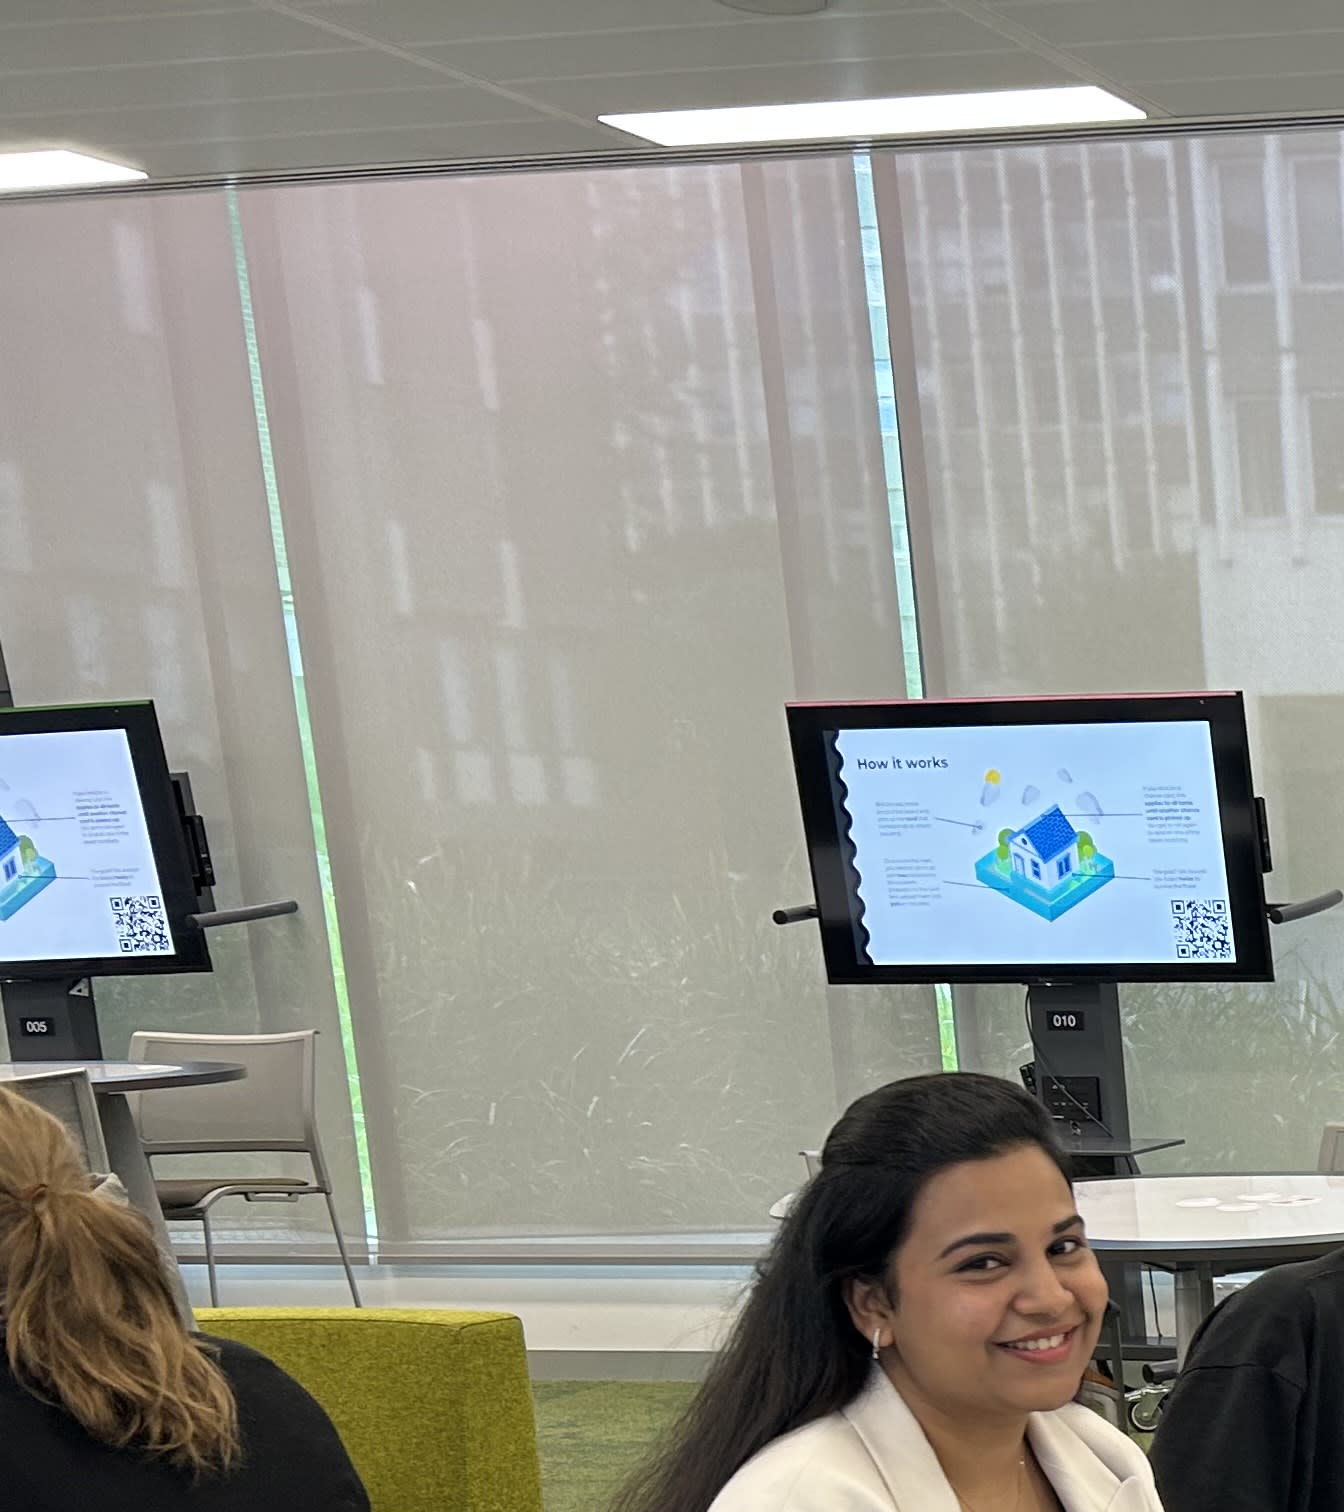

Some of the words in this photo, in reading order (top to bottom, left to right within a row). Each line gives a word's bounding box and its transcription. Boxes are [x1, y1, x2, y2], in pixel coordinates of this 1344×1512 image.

[857, 756, 889, 772] How
[891, 756, 903, 771] it
[904, 755, 949, 771] works
[26, 1020, 48, 1033] 005
[1052, 1014, 1077, 1028] 010
